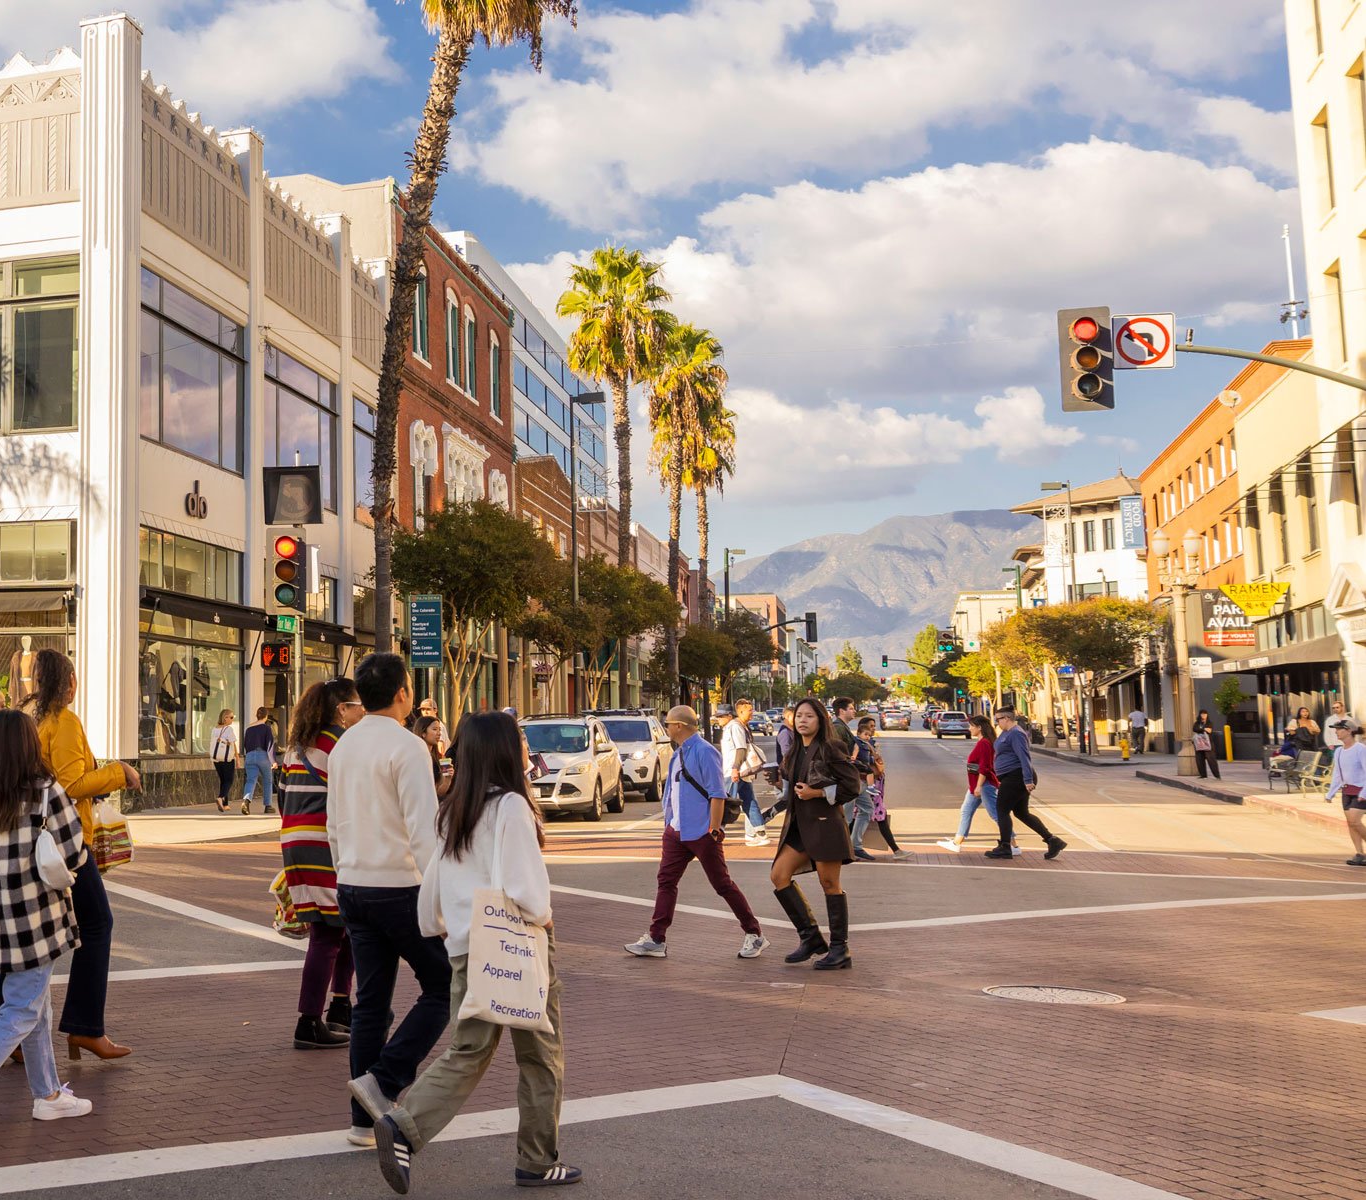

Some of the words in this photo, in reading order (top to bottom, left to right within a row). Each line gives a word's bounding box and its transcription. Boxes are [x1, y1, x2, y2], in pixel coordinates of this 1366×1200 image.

[185, 479, 207, 519] alo
[1123, 502, 1134, 544] DISTRICT
[1132, 501, 1142, 527] FOOD
[1229, 583, 1280, 594] RAMEN
[1213, 604, 1245, 615] PAR
[483, 962, 522, 981] Apparel
[490, 999, 541, 1020] Recreation
